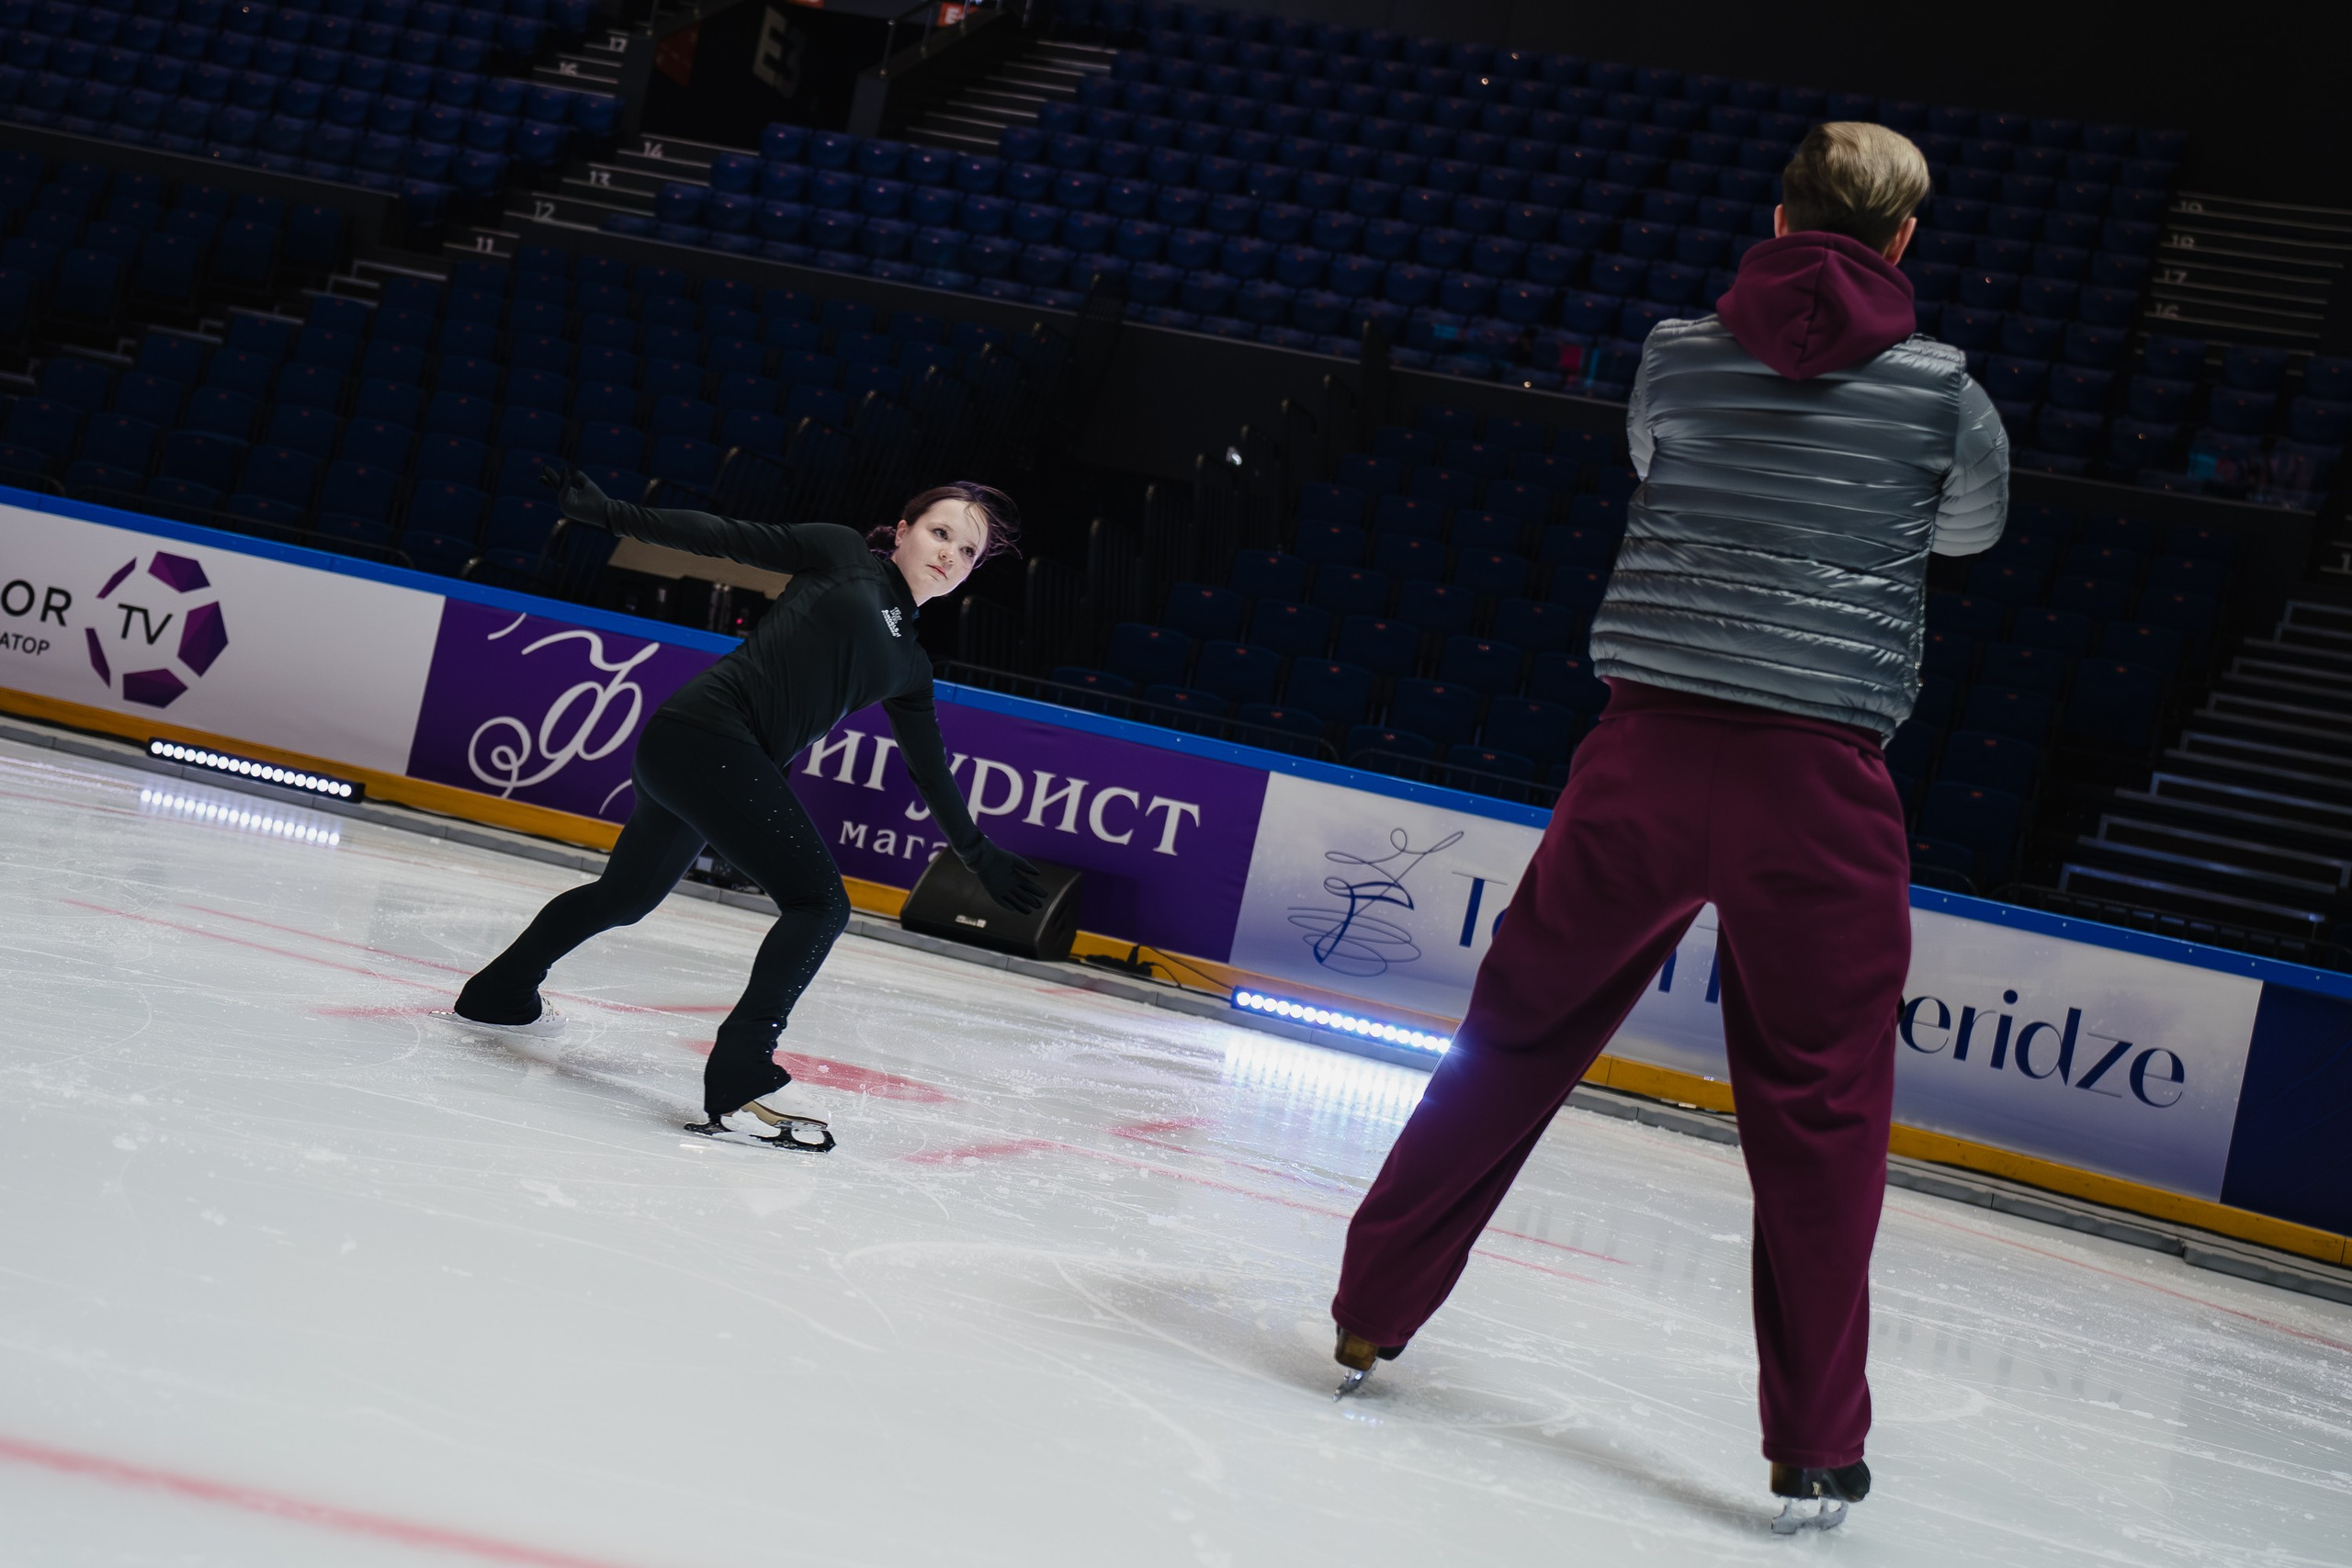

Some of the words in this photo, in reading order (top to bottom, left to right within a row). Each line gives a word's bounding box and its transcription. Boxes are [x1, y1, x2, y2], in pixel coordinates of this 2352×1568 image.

[534, 200, 556, 221] 12
[475, 236, 495, 254] 11
[118, 603, 174, 645] TV
